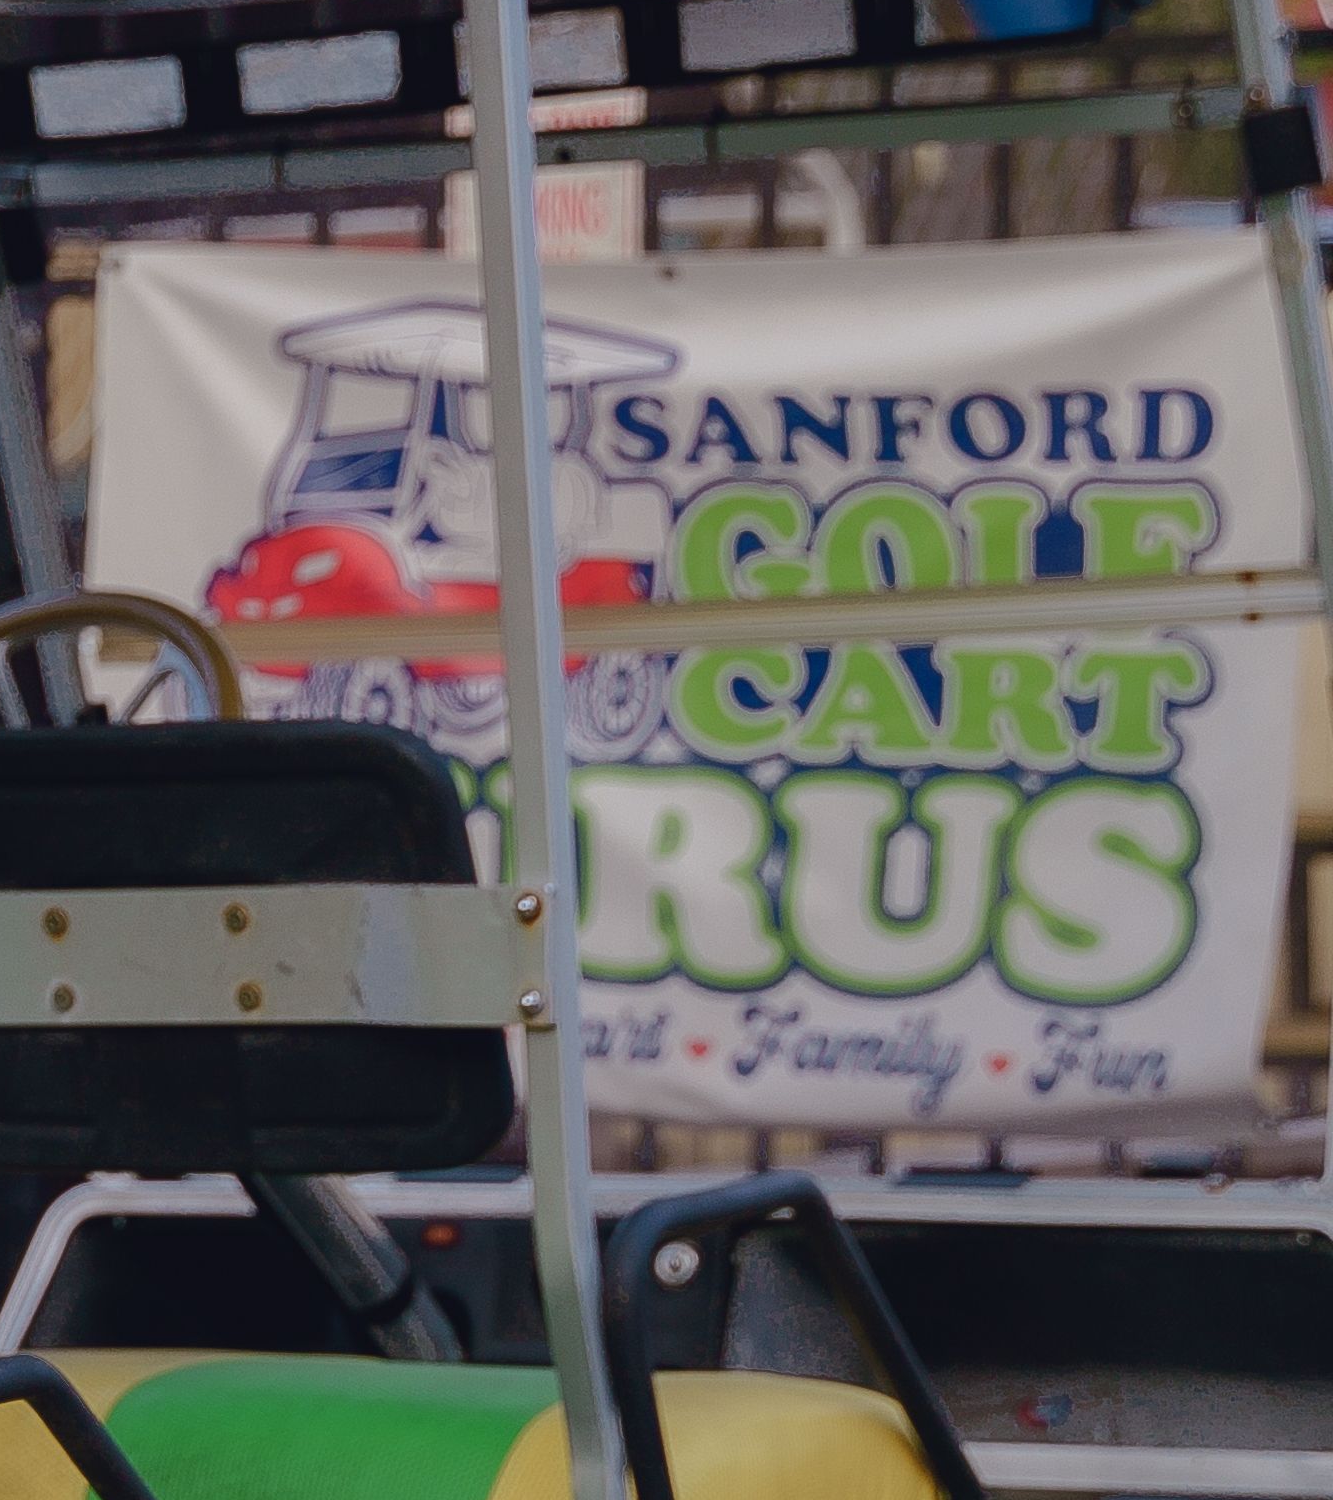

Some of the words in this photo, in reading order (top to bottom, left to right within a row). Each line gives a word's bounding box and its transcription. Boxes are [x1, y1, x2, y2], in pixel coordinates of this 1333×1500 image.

[612, 389, 1213, 464] SANFORD
[677, 488, 1209, 601] GOLF
[675, 644, 1205, 764] CART
[735, 1001, 963, 1117] Family
[1035, 1017, 1165, 1092] Fun
